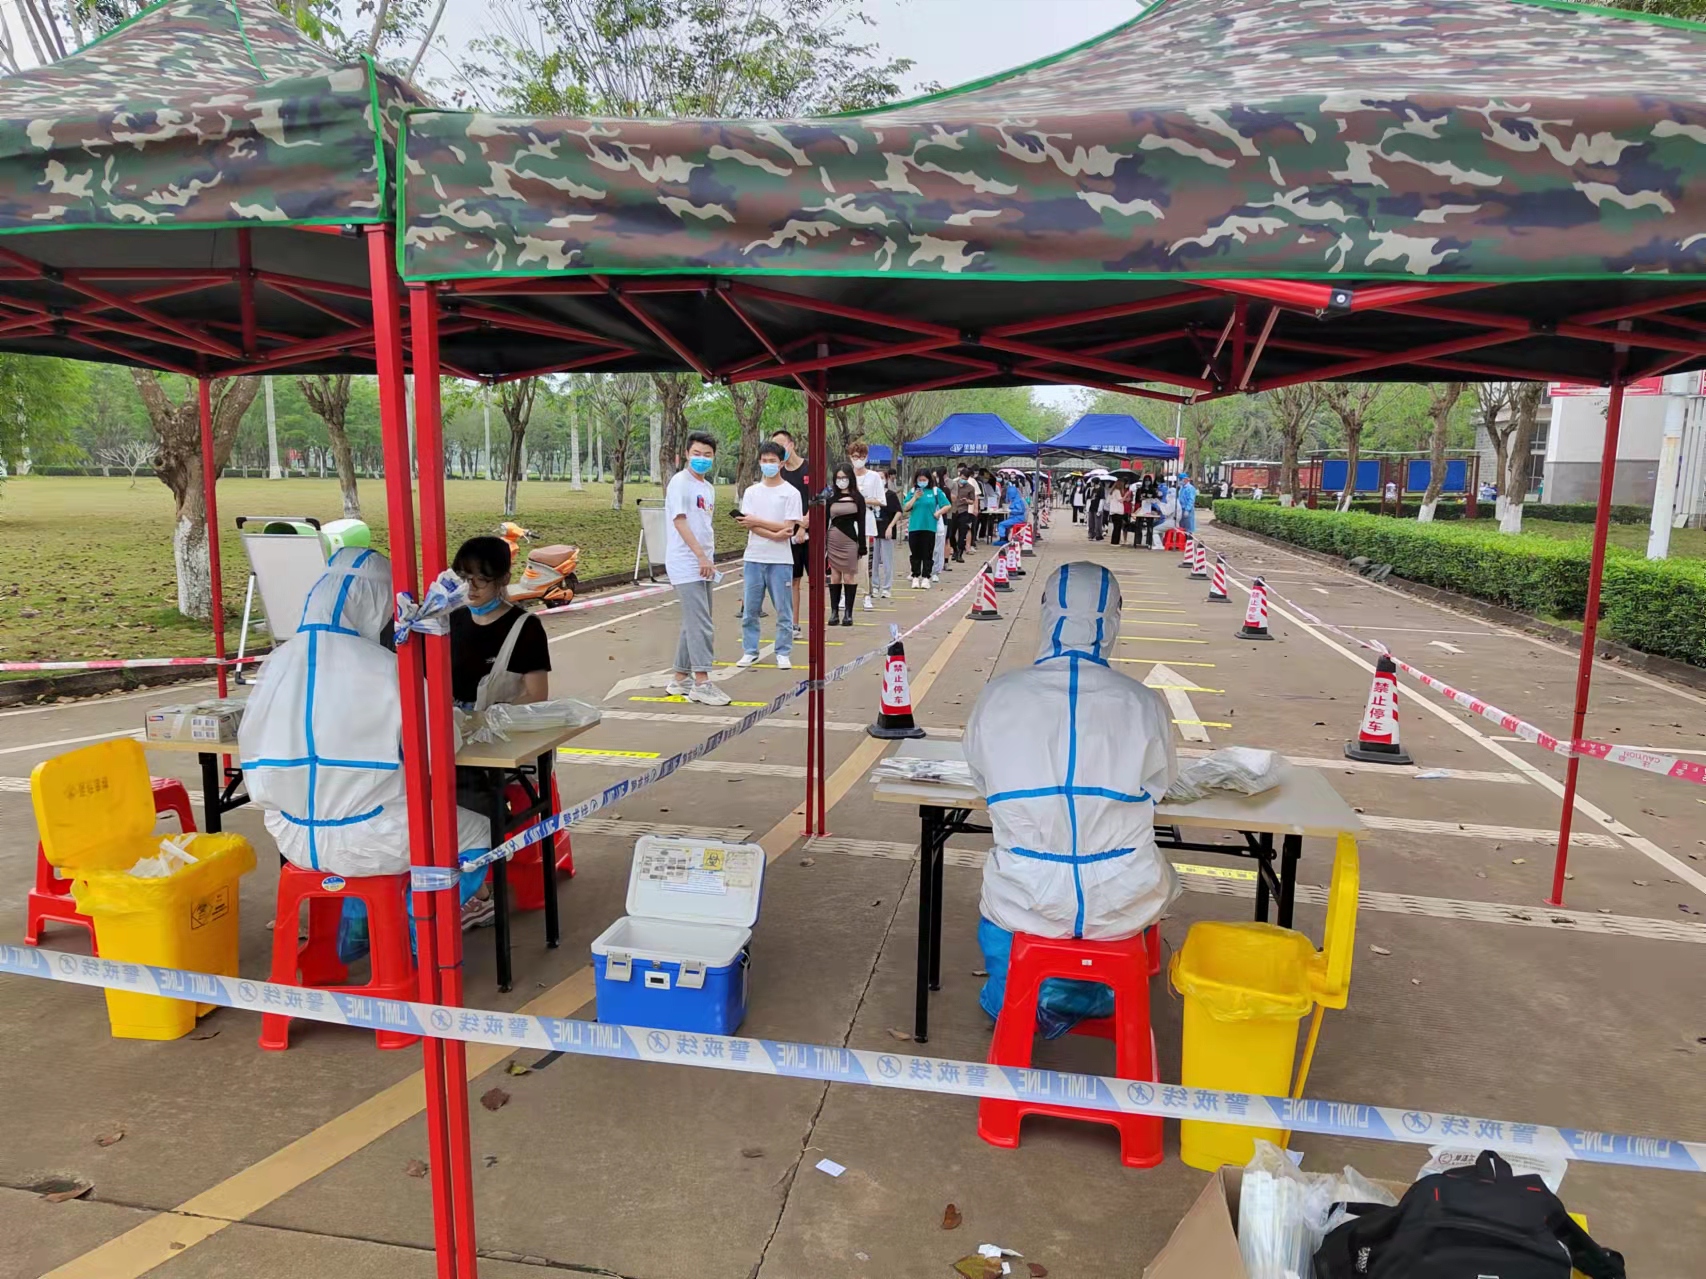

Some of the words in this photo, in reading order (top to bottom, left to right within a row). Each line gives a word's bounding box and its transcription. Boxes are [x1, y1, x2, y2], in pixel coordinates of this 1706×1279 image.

[893, 664, 904, 704] 禁止停车
[1367, 681, 1389, 732] 禁止停车
[1623, 751, 1661, 764] CAUTION
